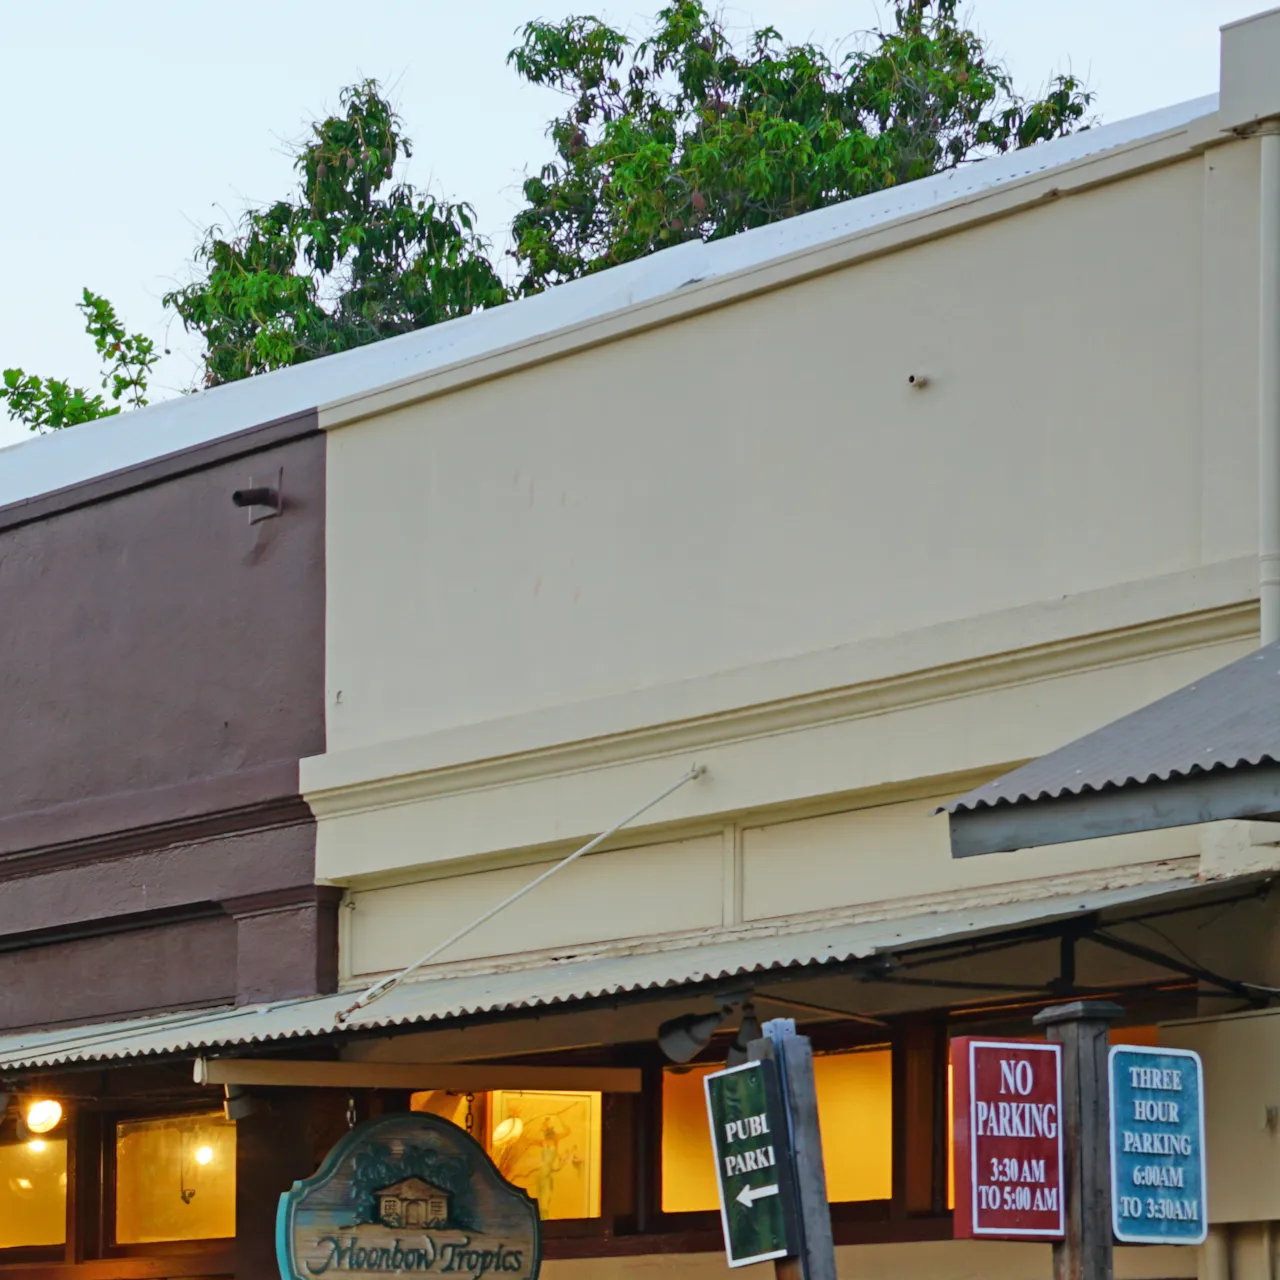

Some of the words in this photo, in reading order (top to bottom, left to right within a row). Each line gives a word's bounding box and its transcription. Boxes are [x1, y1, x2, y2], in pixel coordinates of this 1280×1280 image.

[1000, 1060, 1033, 1095] NO
[1129, 1067, 1182, 1090] THREE
[976, 1101, 1057, 1139] PARKING
[1134, 1100, 1179, 1122] HOUR
[724, 1113, 771, 1144] PUBL
[1123, 1130, 1191, 1155] PARKING
[724, 1145, 776, 1177] PARKI
[990, 1158, 1018, 1182] 3:30
[1020, 1159, 1045, 1183] AM
[1133, 1166, 1183, 1188] 6:00AM
[979, 1186, 1000, 1210] TO
[1004, 1186, 1031, 1211] 5:00
[1033, 1187, 1058, 1211] AM
[1121, 1197, 1141, 1218] TO
[1146, 1198, 1198, 1221] 3:30AM
[304, 1234, 437, 1275] Moonbow
